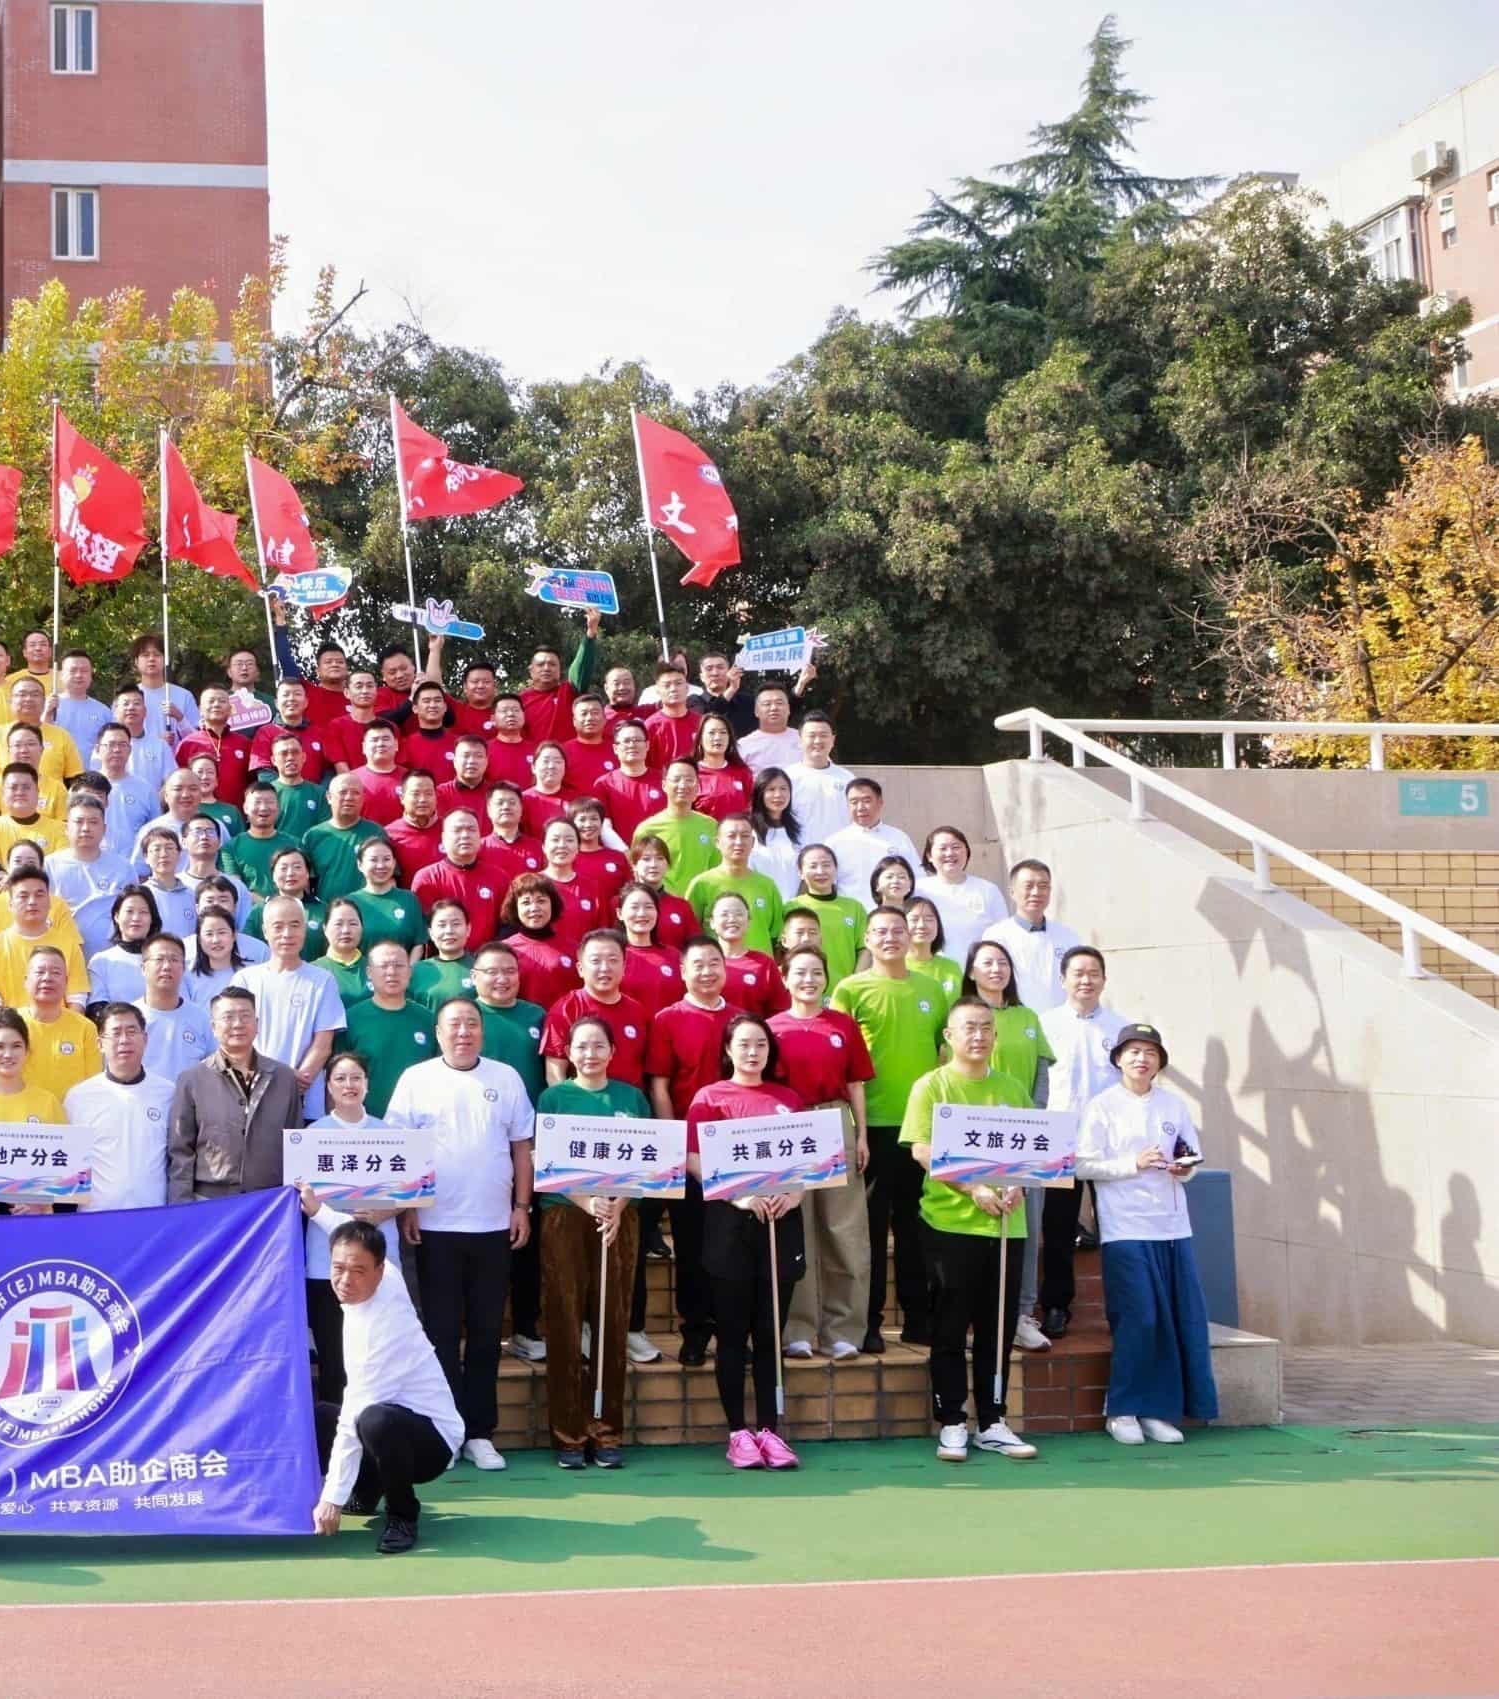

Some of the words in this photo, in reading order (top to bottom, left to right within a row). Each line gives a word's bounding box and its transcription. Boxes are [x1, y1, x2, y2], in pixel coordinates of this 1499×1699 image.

[659, 491, 697, 534] 文
[1459, 783, 1479, 812] 5
[569, 1139, 658, 1162] 健康分会
[732, 1136, 818, 1161] 共赢分会
[964, 1129, 1050, 1152] 文旅分会
[317, 1153, 407, 1173] 惠泽分会
[50, 1497, 119, 1512] 共享资源
[133, 1490, 205, 1510] 共同发展
